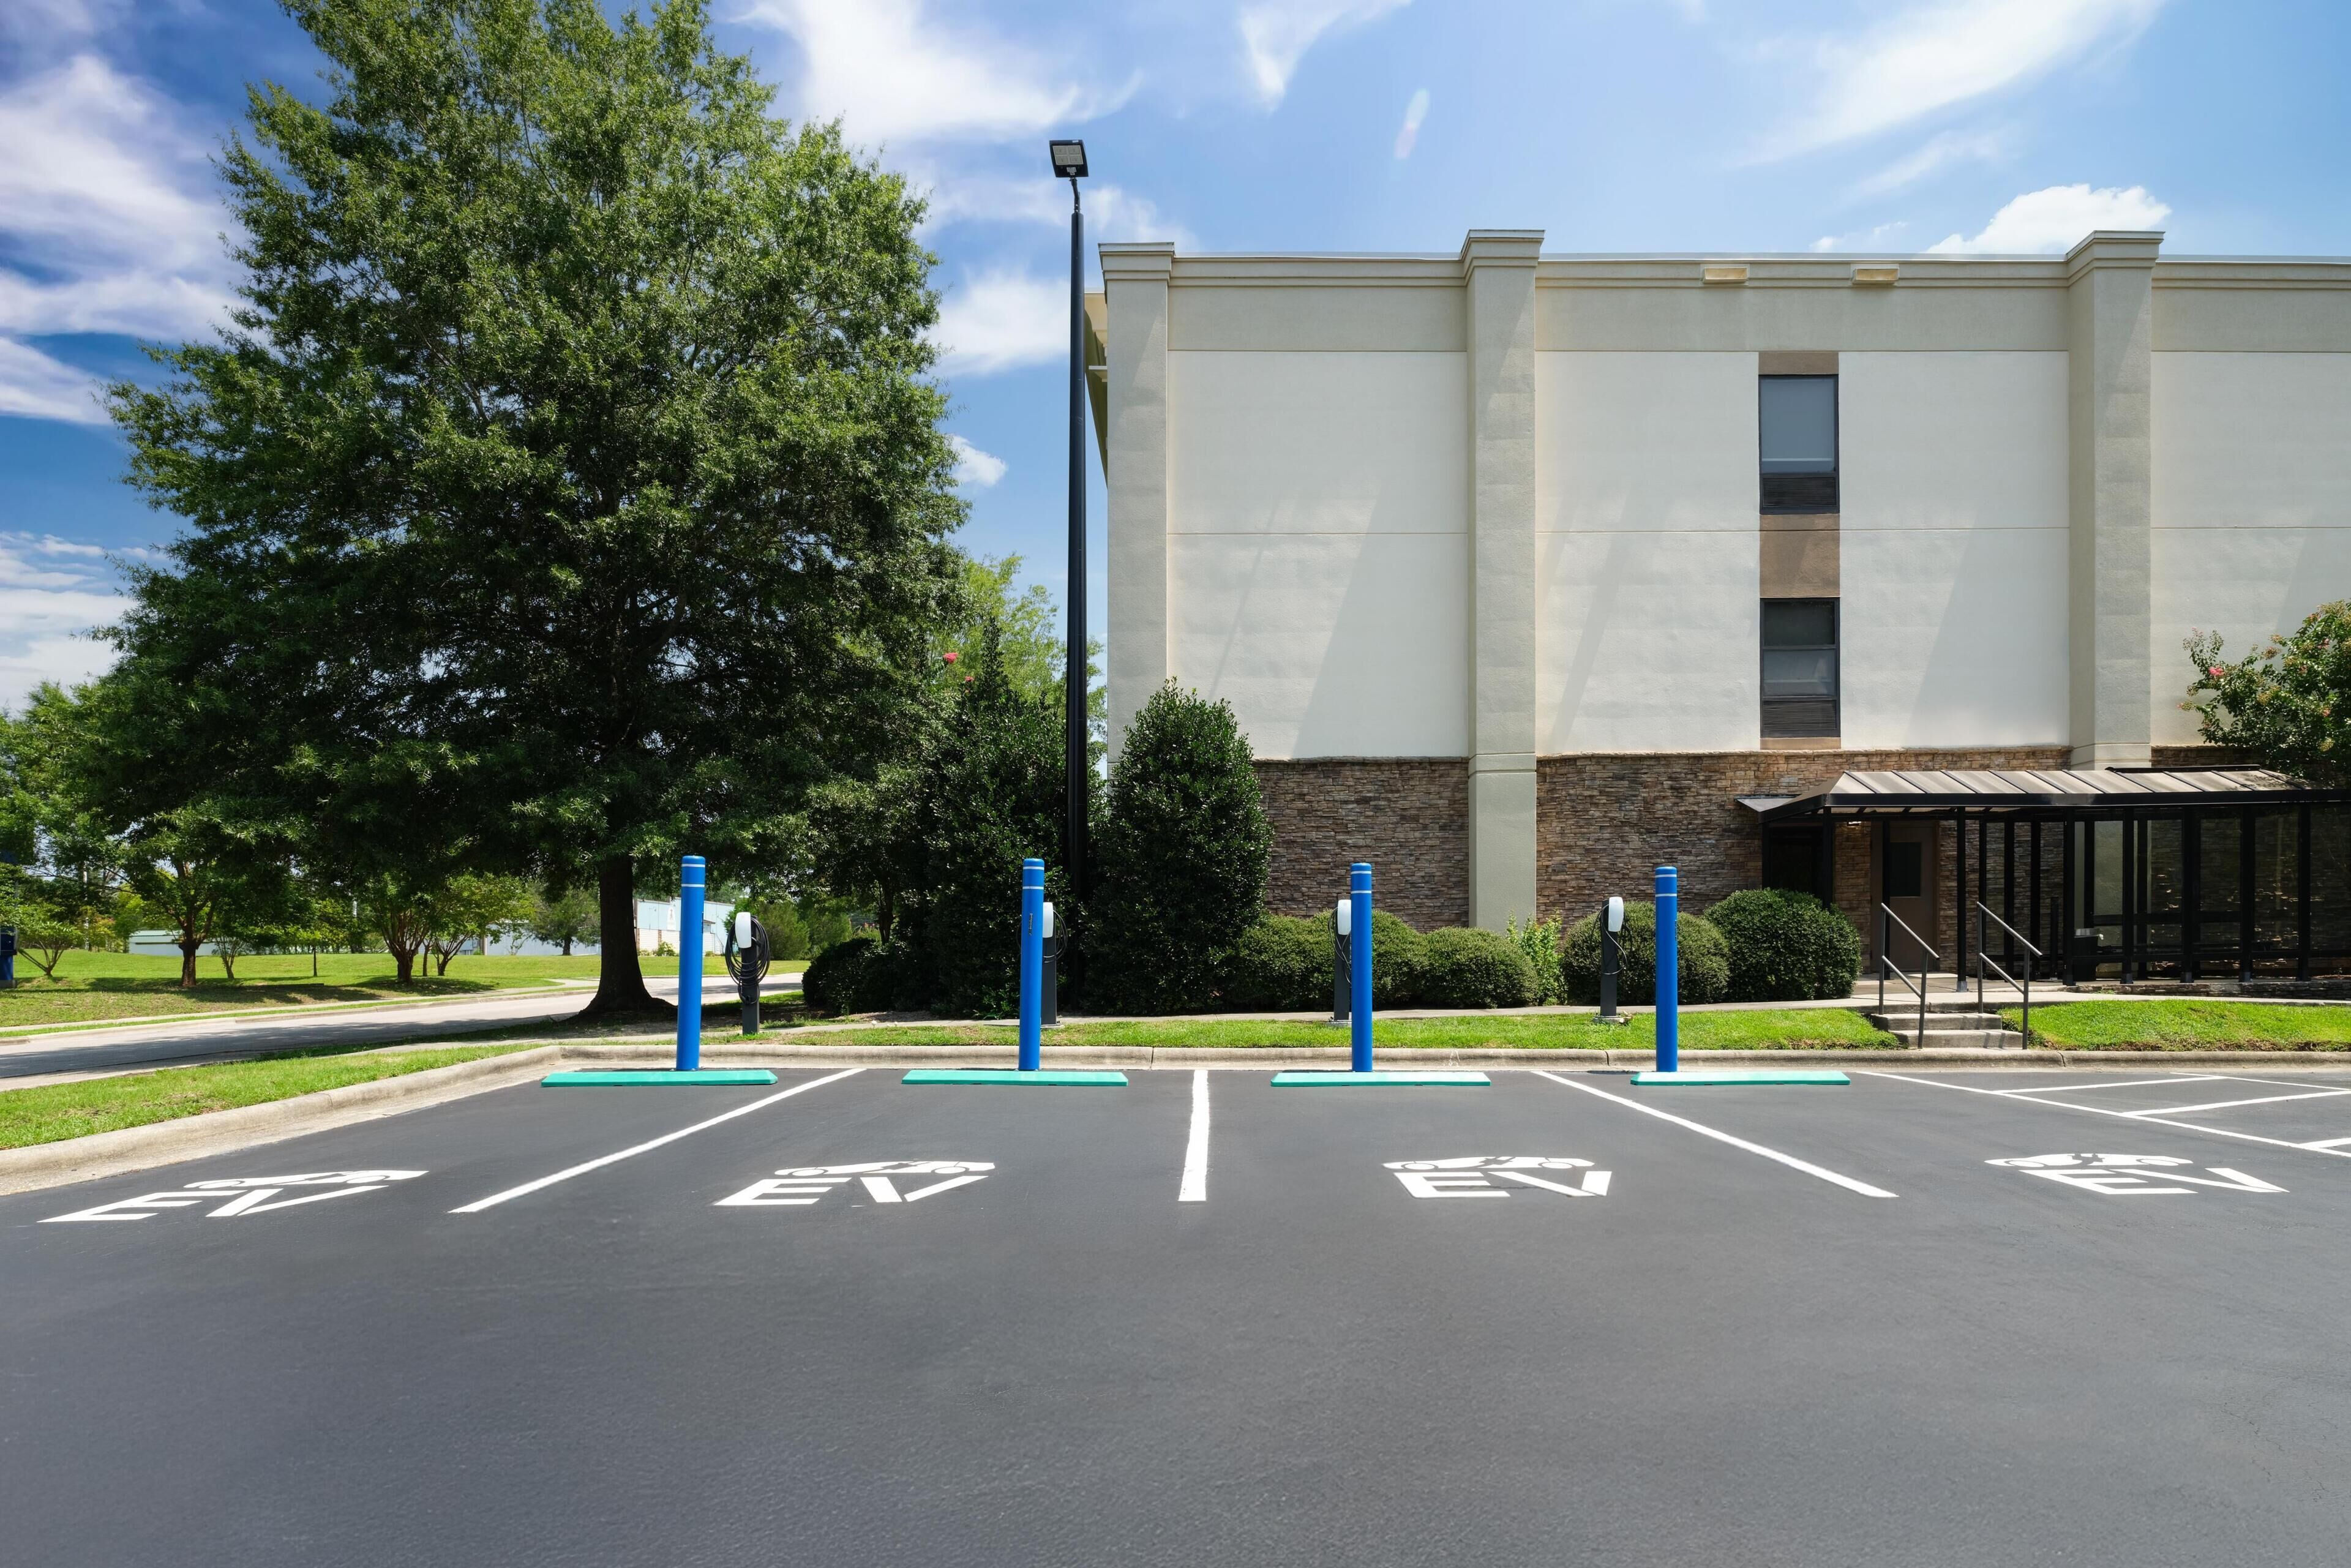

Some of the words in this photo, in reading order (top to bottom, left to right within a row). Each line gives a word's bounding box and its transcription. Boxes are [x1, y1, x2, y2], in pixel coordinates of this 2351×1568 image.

[713, 1176, 989, 1206] EV
[1393, 1171, 1612, 1198] EV
[2018, 1168, 2290, 1195] EV
[37, 1185, 388, 1222] EV
